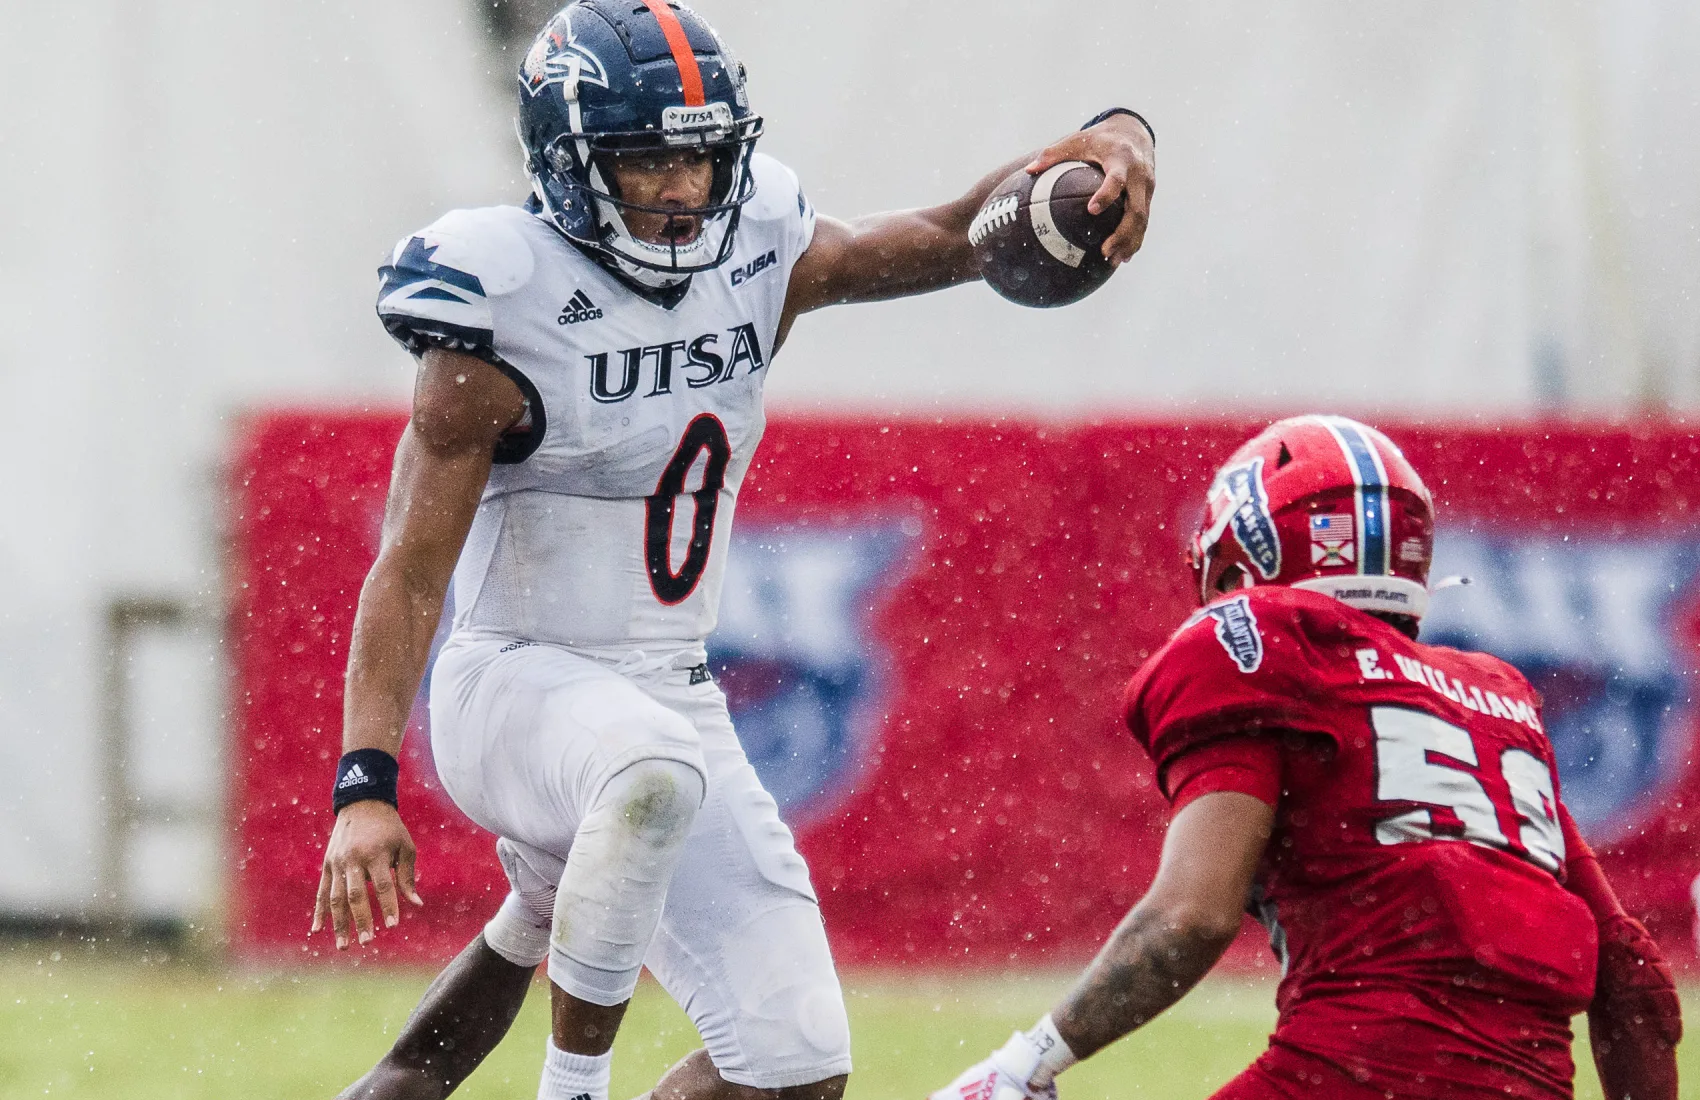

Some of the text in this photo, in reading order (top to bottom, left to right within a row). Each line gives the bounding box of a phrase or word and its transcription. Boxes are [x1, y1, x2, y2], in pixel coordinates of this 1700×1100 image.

[680, 111, 714, 124] UTSA
[557, 307, 603, 326] adidas
[584, 322, 764, 404] UTSA
[644, 412, 732, 606] 0
[1355, 648, 1395, 680] E.
[339, 775, 369, 789] adidas
